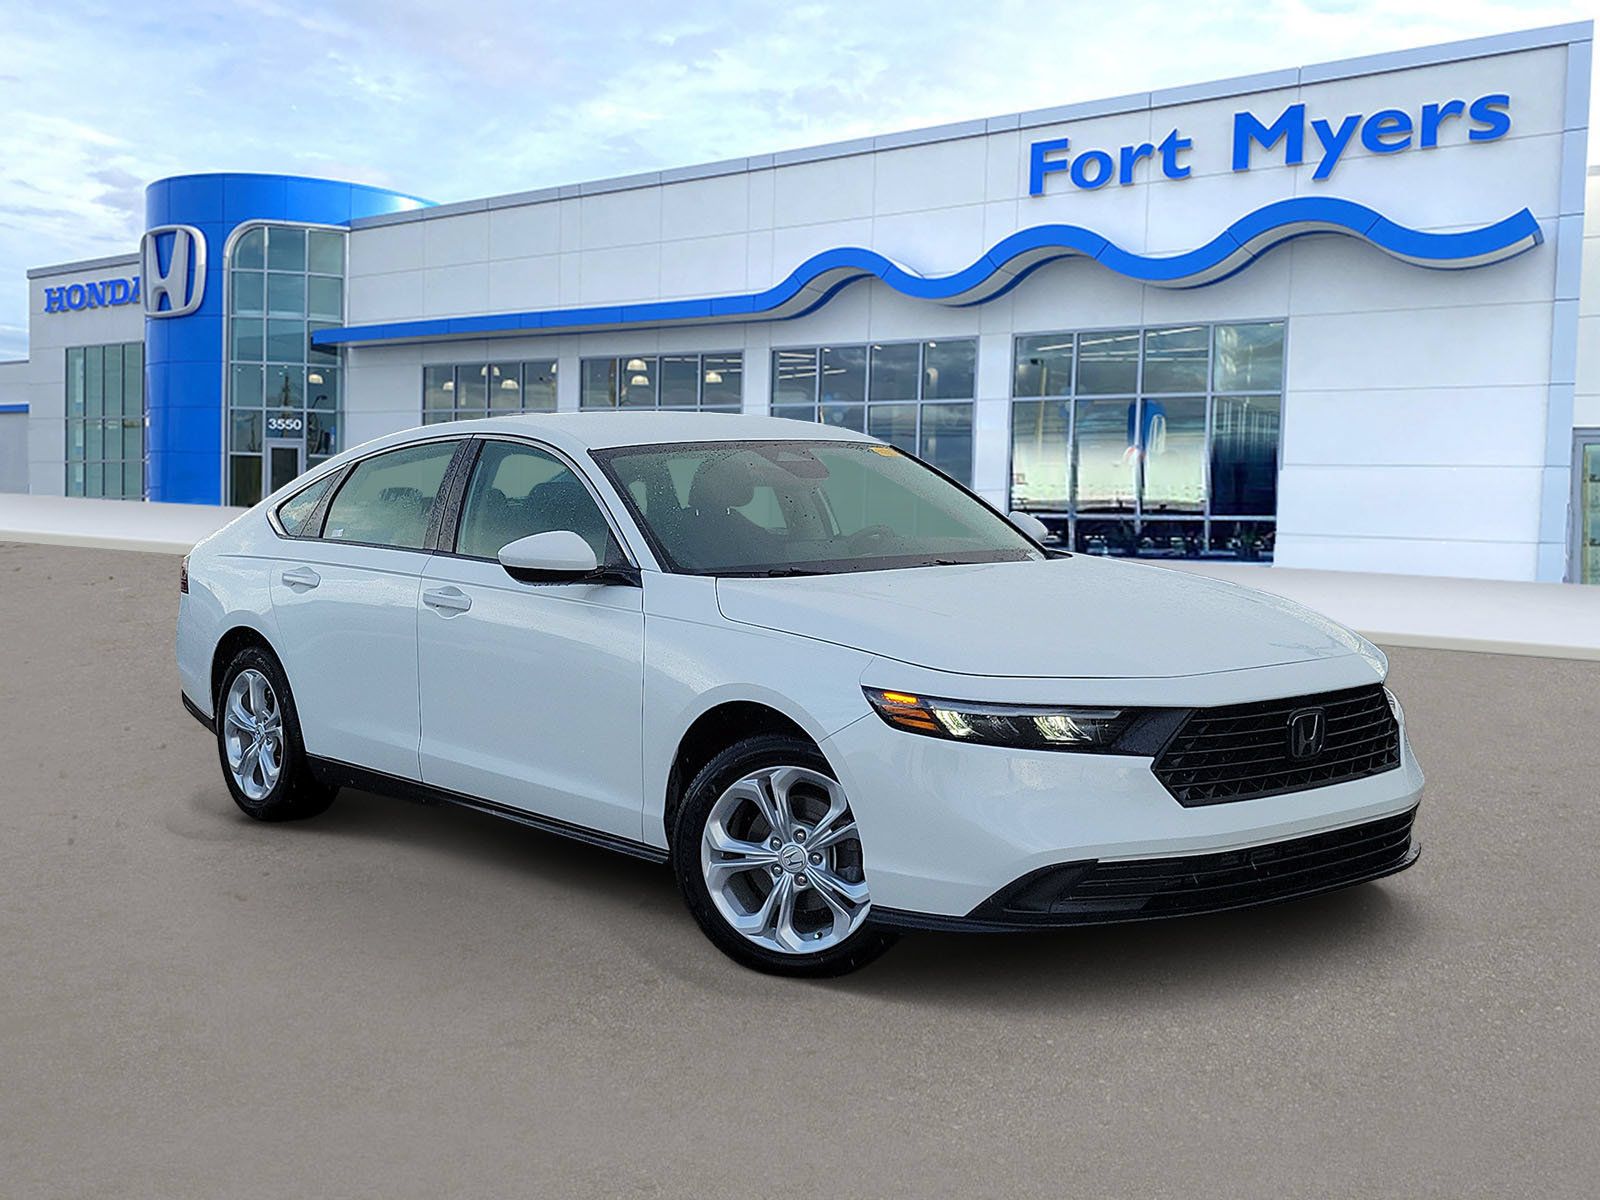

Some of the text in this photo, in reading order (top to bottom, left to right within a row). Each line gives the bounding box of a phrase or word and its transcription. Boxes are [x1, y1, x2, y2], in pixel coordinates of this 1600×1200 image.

[1029, 94, 1511, 197] Fort Myers
[268, 418, 302, 430] 3550
